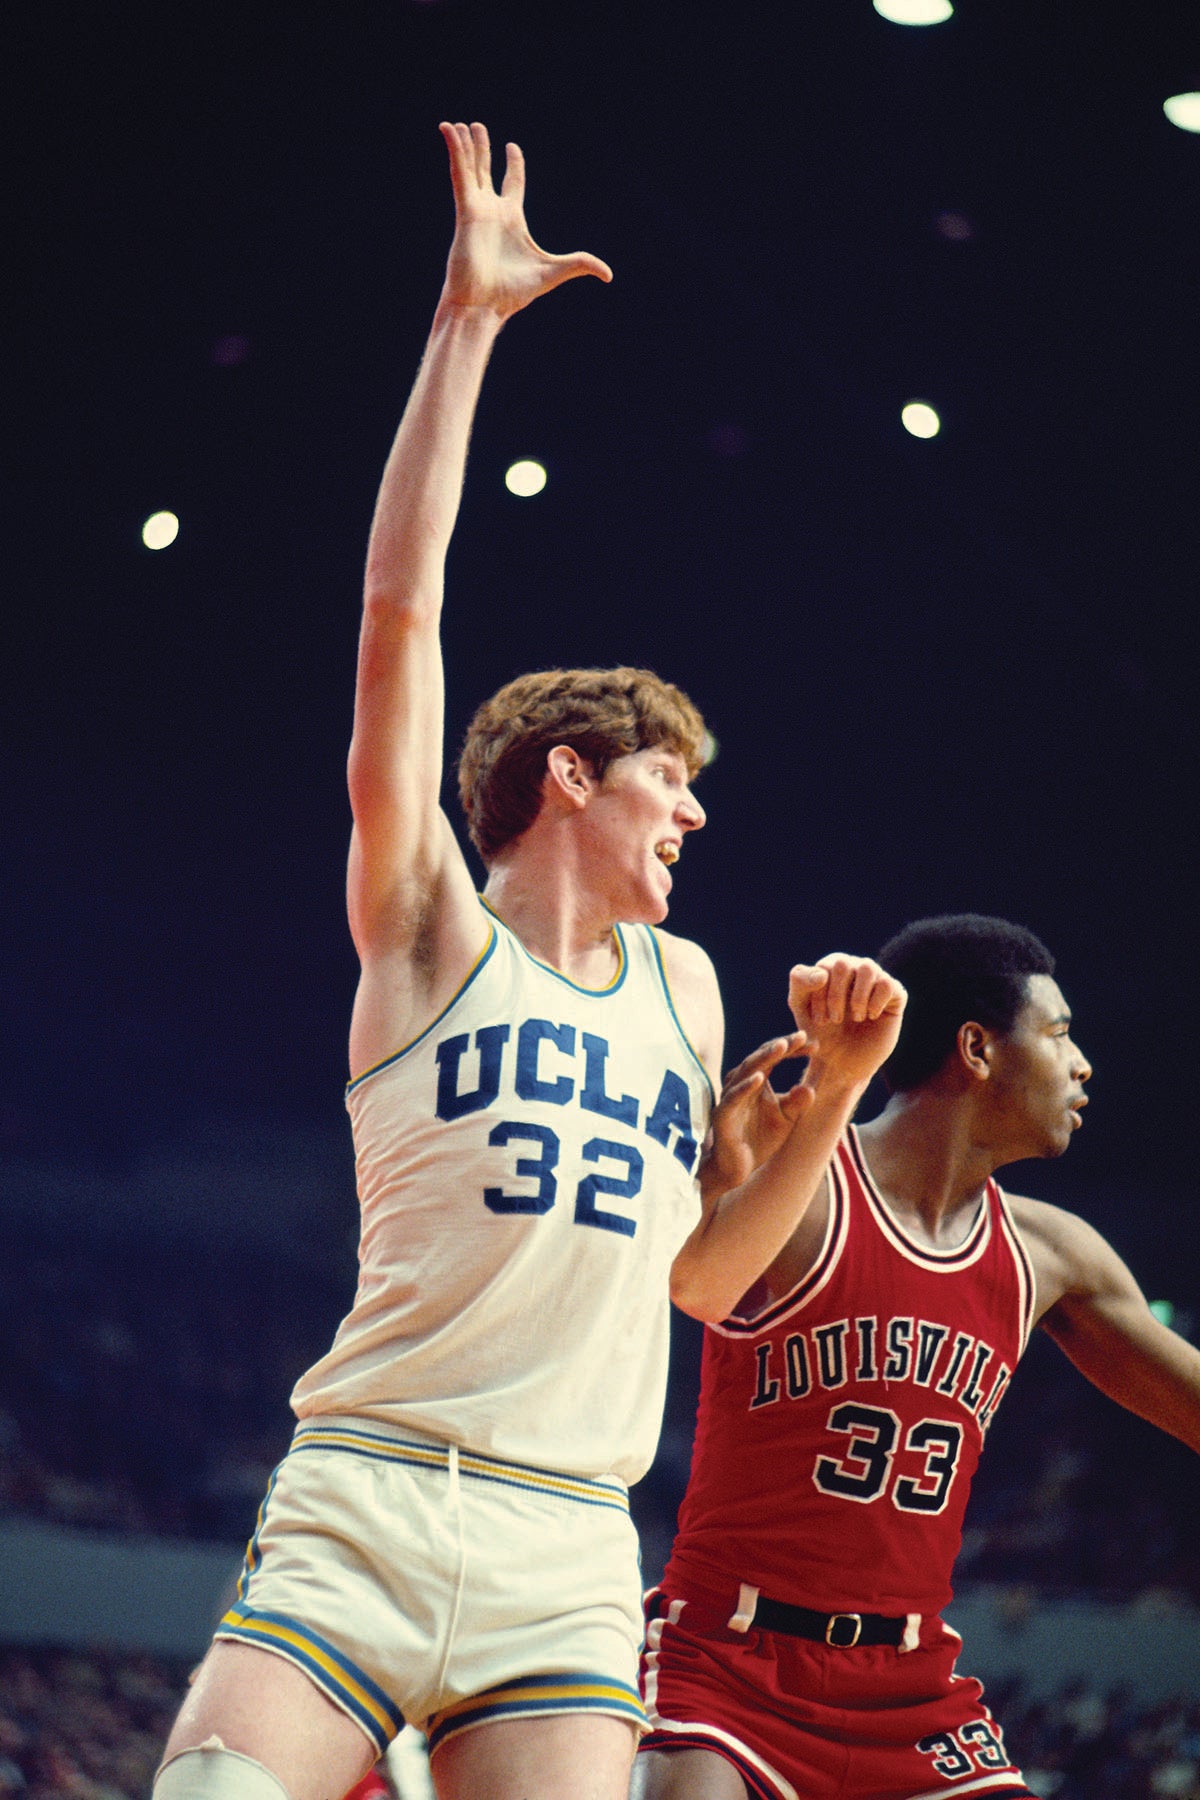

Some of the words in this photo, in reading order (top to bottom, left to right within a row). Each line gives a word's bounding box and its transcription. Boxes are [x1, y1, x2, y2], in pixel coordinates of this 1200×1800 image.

[435, 1018, 698, 1175] UCLA
[483, 1121, 644, 1239] 32
[748, 1315, 1011, 1432] LOUISVILL
[812, 1400, 964, 1516] 33
[915, 1718, 1011, 1780] 33
